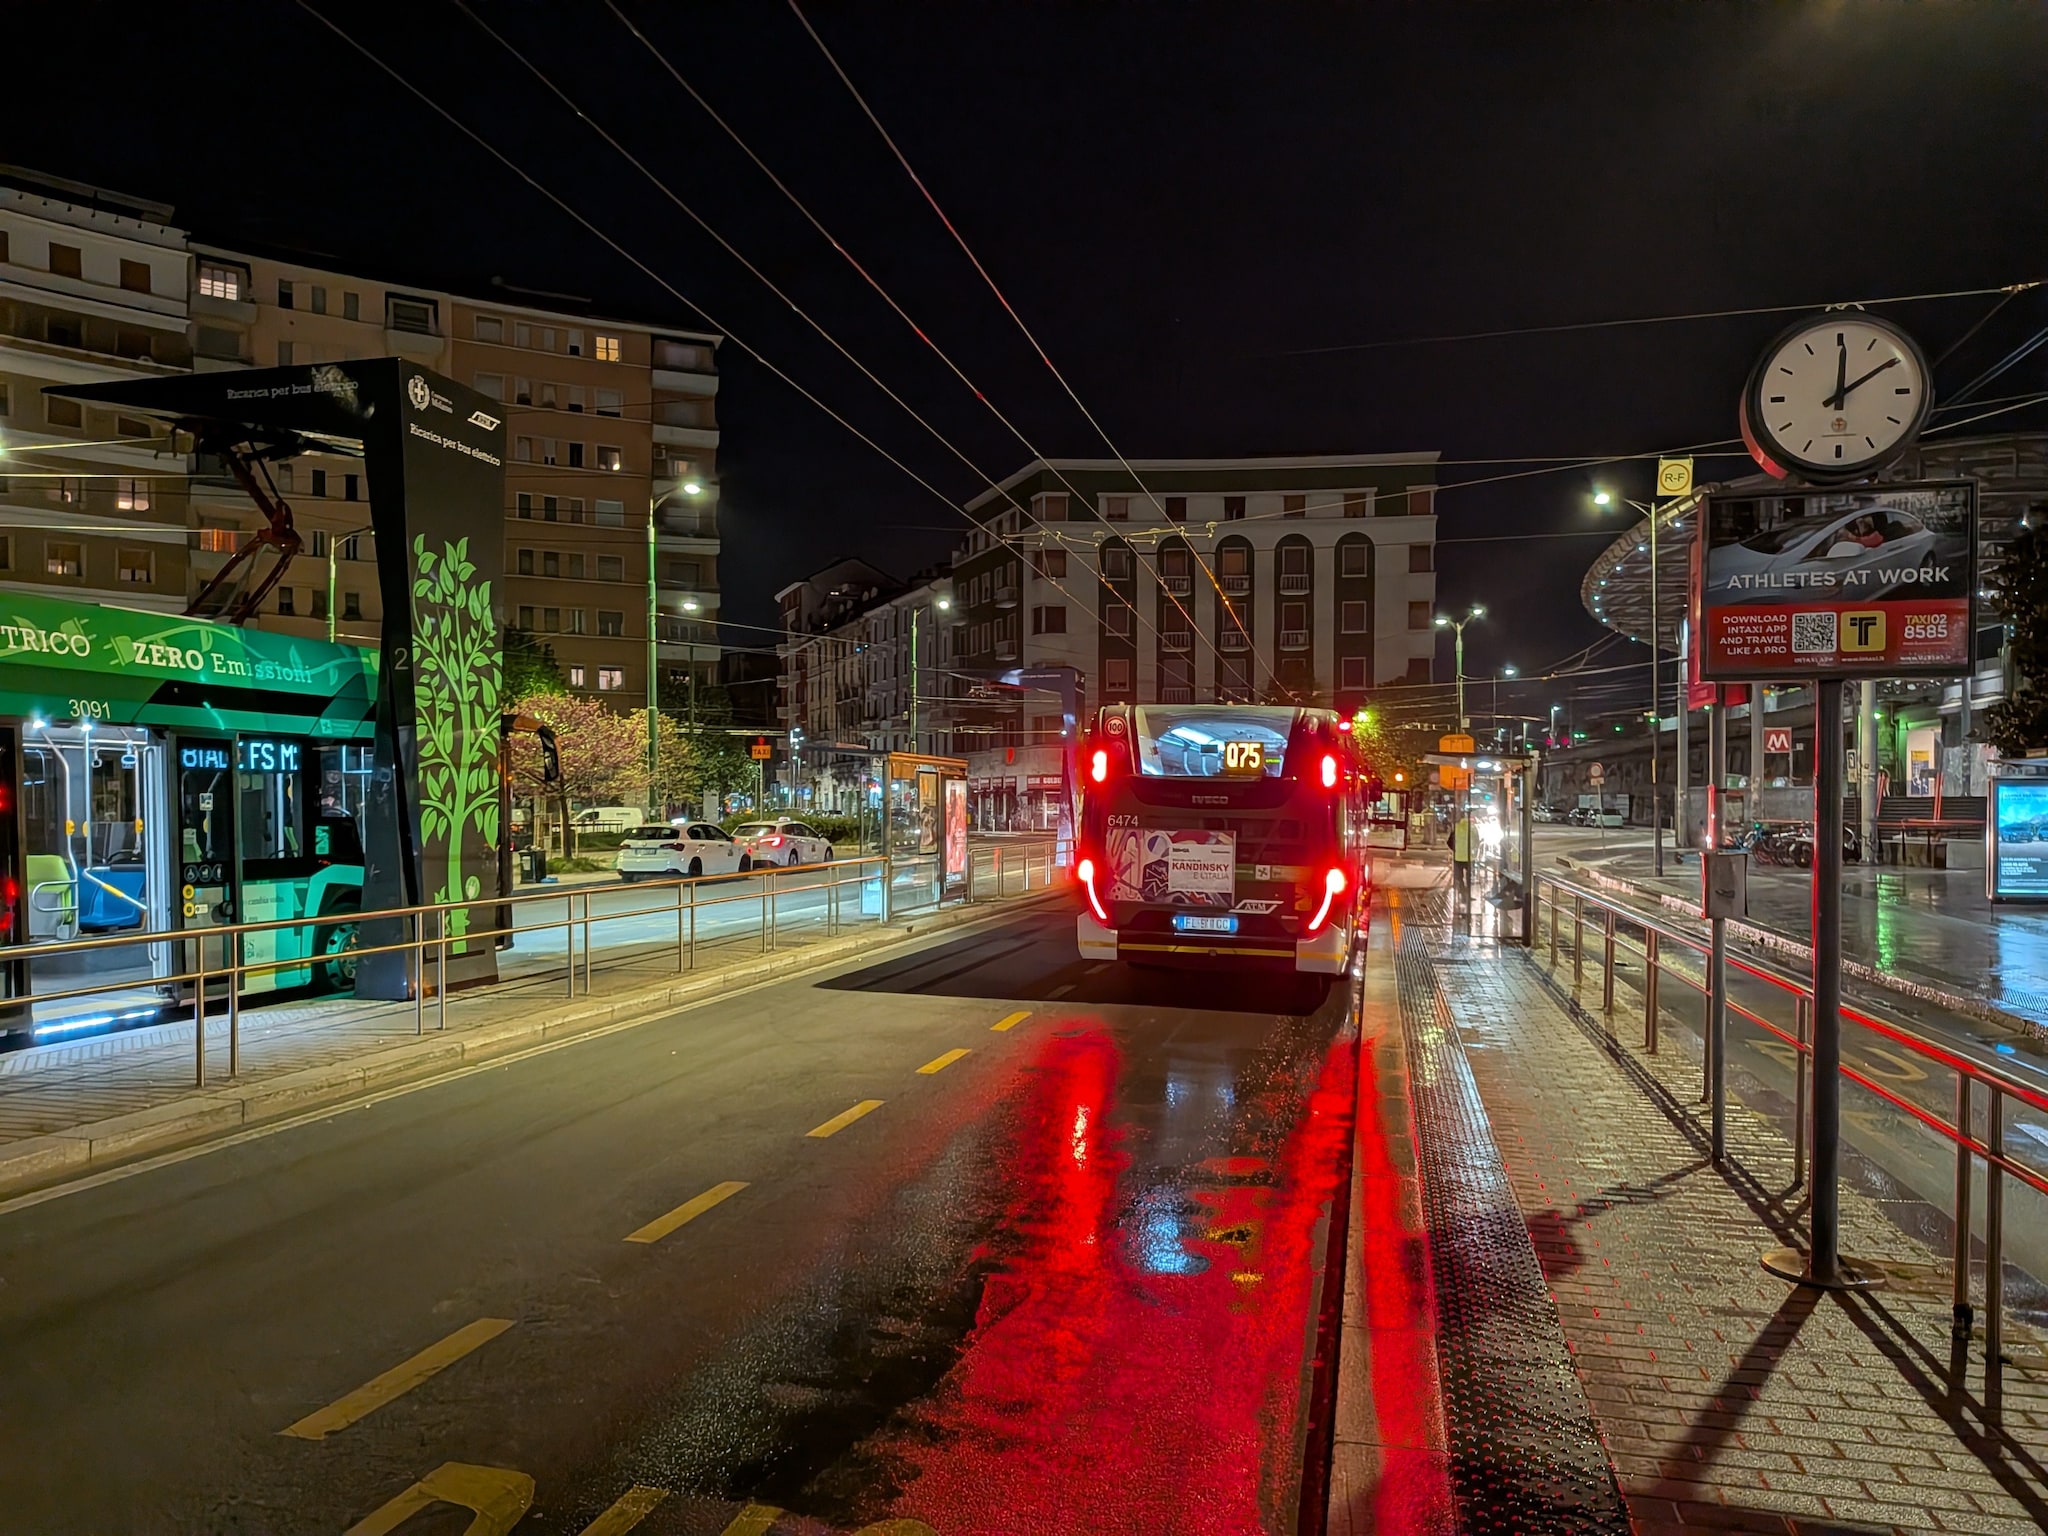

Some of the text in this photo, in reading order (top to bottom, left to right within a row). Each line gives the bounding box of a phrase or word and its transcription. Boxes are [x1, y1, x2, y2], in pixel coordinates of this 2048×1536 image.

[271, 386, 290, 399] per
[292, 383, 312, 395] bus
[410, 423, 442, 445] Ricarica
[442, 437, 457, 449] per
[457, 441, 472, 455] bus
[1664, 472, 1685, 483] R-F
[1727, 566, 1950, 590] ATHLETES AT WORK
[1722, 614, 1787, 624] DOWNLOAD
[1727, 624, 1787, 634] INTAXI APP
[1904, 624, 1948, 639] 8585
[1720, 634, 1787, 645] AND TRAVEL
[1727, 645, 1787, 655] LIKE A PRO
[132, 641, 205, 671] ZERO
[212, 651, 313, 684] Emissioni
[394, 647, 409, 670] 2
[69, 699, 111, 720] 3091
[1108, 722, 1123, 732] 100
[250, 742, 275, 770] FS
[1226, 742, 1261, 769] 075
[1192, 795, 1229, 805] IVECO
[1107, 814, 1139, 827] 6474
[1171, 862, 1230, 873] KANDINSKY
[1245, 902, 1267, 912] ATM
